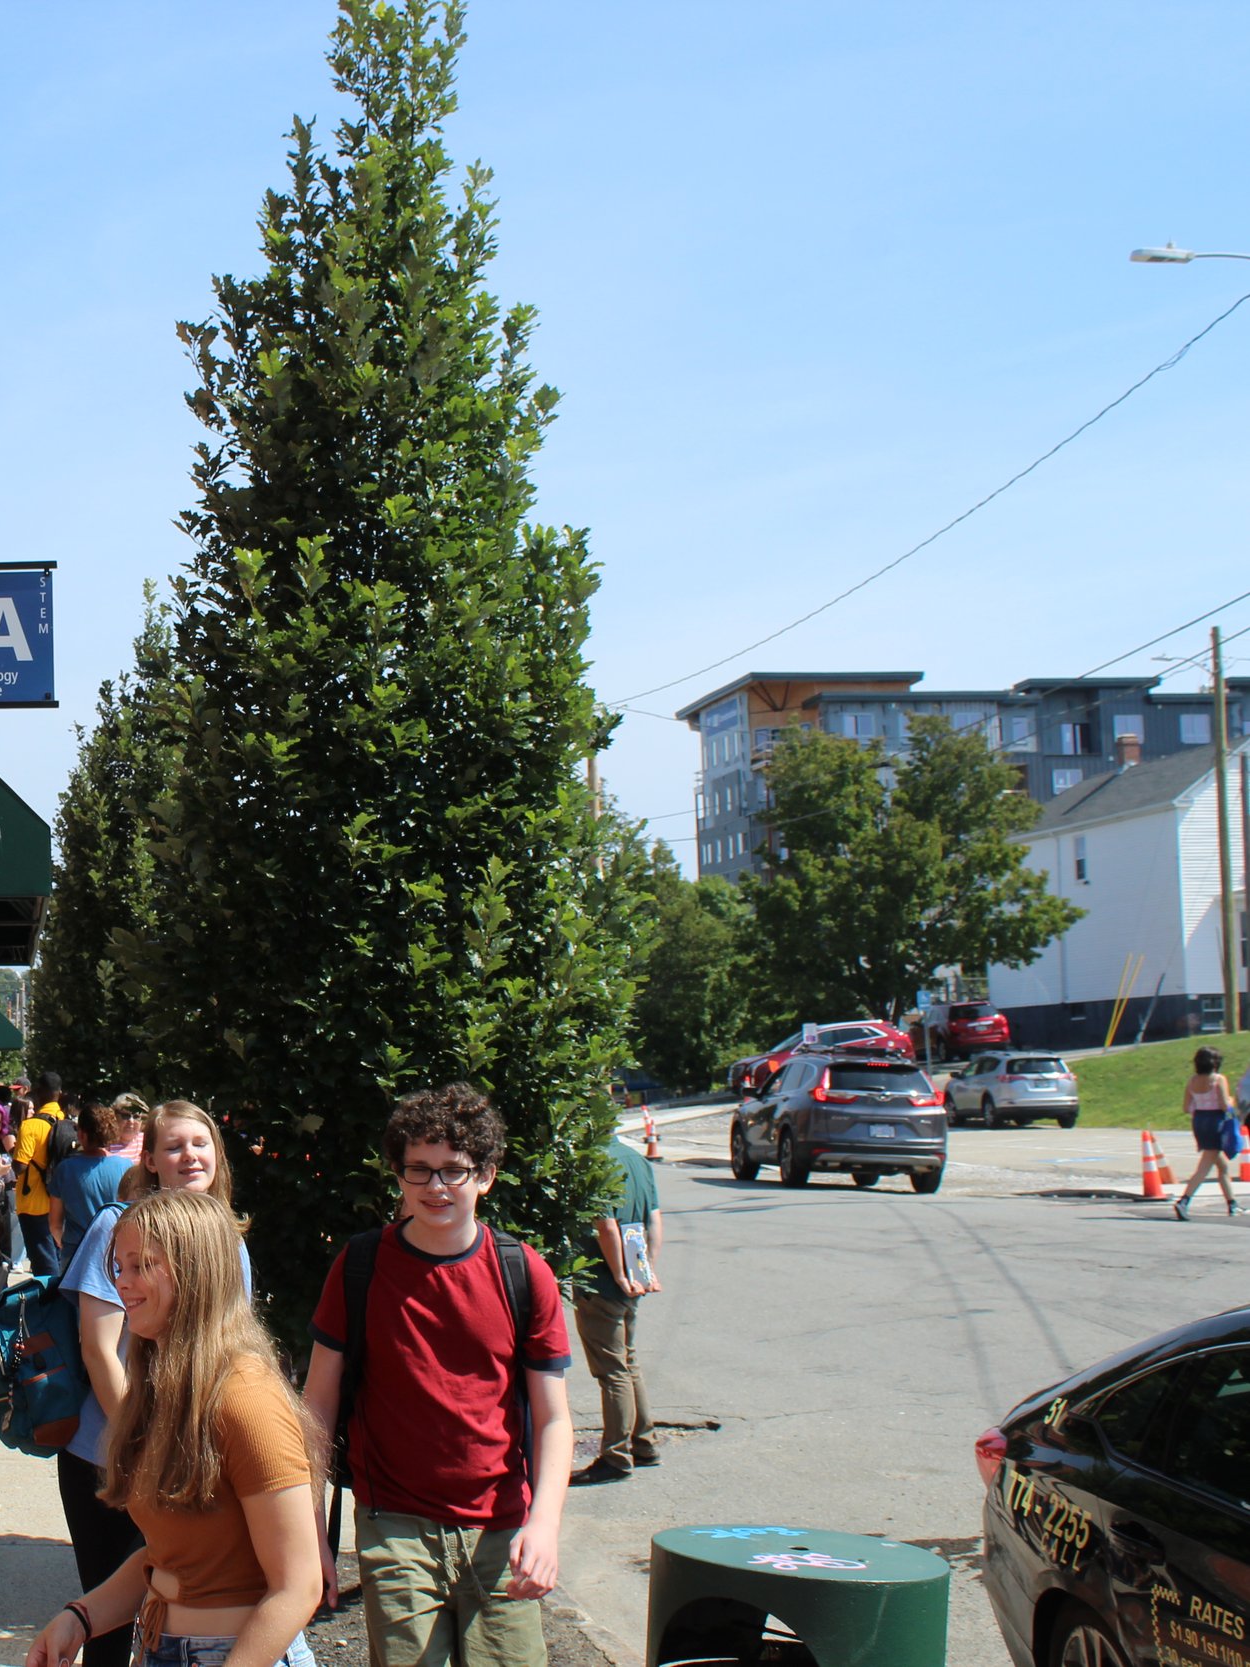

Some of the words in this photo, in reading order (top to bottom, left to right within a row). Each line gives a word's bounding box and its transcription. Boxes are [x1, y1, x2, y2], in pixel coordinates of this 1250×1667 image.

[38, 576, 49, 634] STEM
[1041, 1531, 1081, 1573] CALL
[1190, 1595, 1245, 1640] RATES
